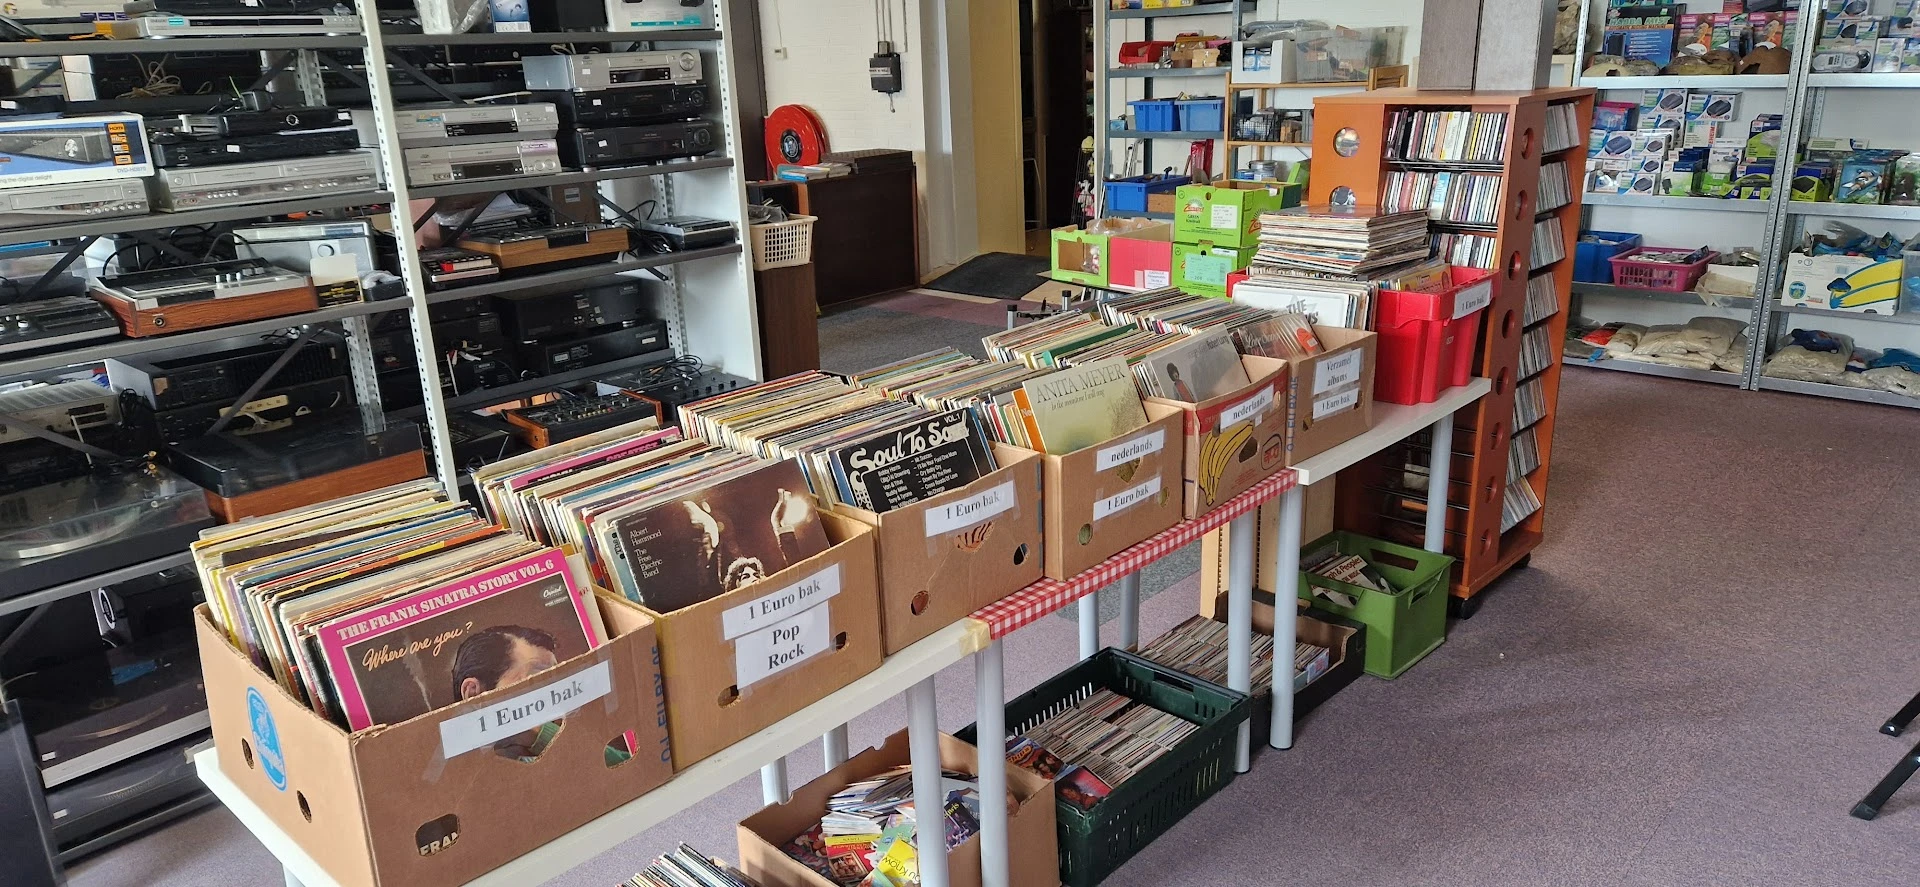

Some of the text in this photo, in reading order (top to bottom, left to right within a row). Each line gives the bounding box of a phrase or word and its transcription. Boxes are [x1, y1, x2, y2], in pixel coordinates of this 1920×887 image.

[1644, 16, 1672, 25] MIST
[1286, 299, 1307, 314] THE
[1326, 355, 1352, 371] Verzamel
[1037, 363, 1126, 403] ANITA MEYER
[1327, 373, 1348, 386] albums
[1233, 395, 1266, 419] nederlands
[1326, 399, 1340, 410] Euro
[1340, 395, 1351, 405] bak
[850, 431, 905, 471] Soul
[903, 425, 926, 454] To
[1111, 440, 1153, 462] nederlands
[946, 491, 1000, 519] 1 Euro bak
[1108, 485, 1149, 510] 1 Euro bak
[630, 527, 648, 539] Albert
[632, 529, 662, 546] Hammond
[634, 548, 647, 557] The
[638, 555, 652, 564] Free
[640, 559, 663, 571] Electric
[643, 568, 660, 579] Band
[1341, 556, 1363, 573] Peoples
[337, 620, 369, 641] THE
[369, 605, 420, 633] FRANK
[420, 585, 479, 614] SINATRA
[477, 571, 521, 595] STORY
[749, 580, 821, 620] 1 Euro bak
[772, 625, 800, 645] Pop
[362, 644, 409, 672] Where
[409, 637, 433, 655] are
[768, 643, 805, 670] Rock
[478, 679, 584, 733] 1 Euro bak
